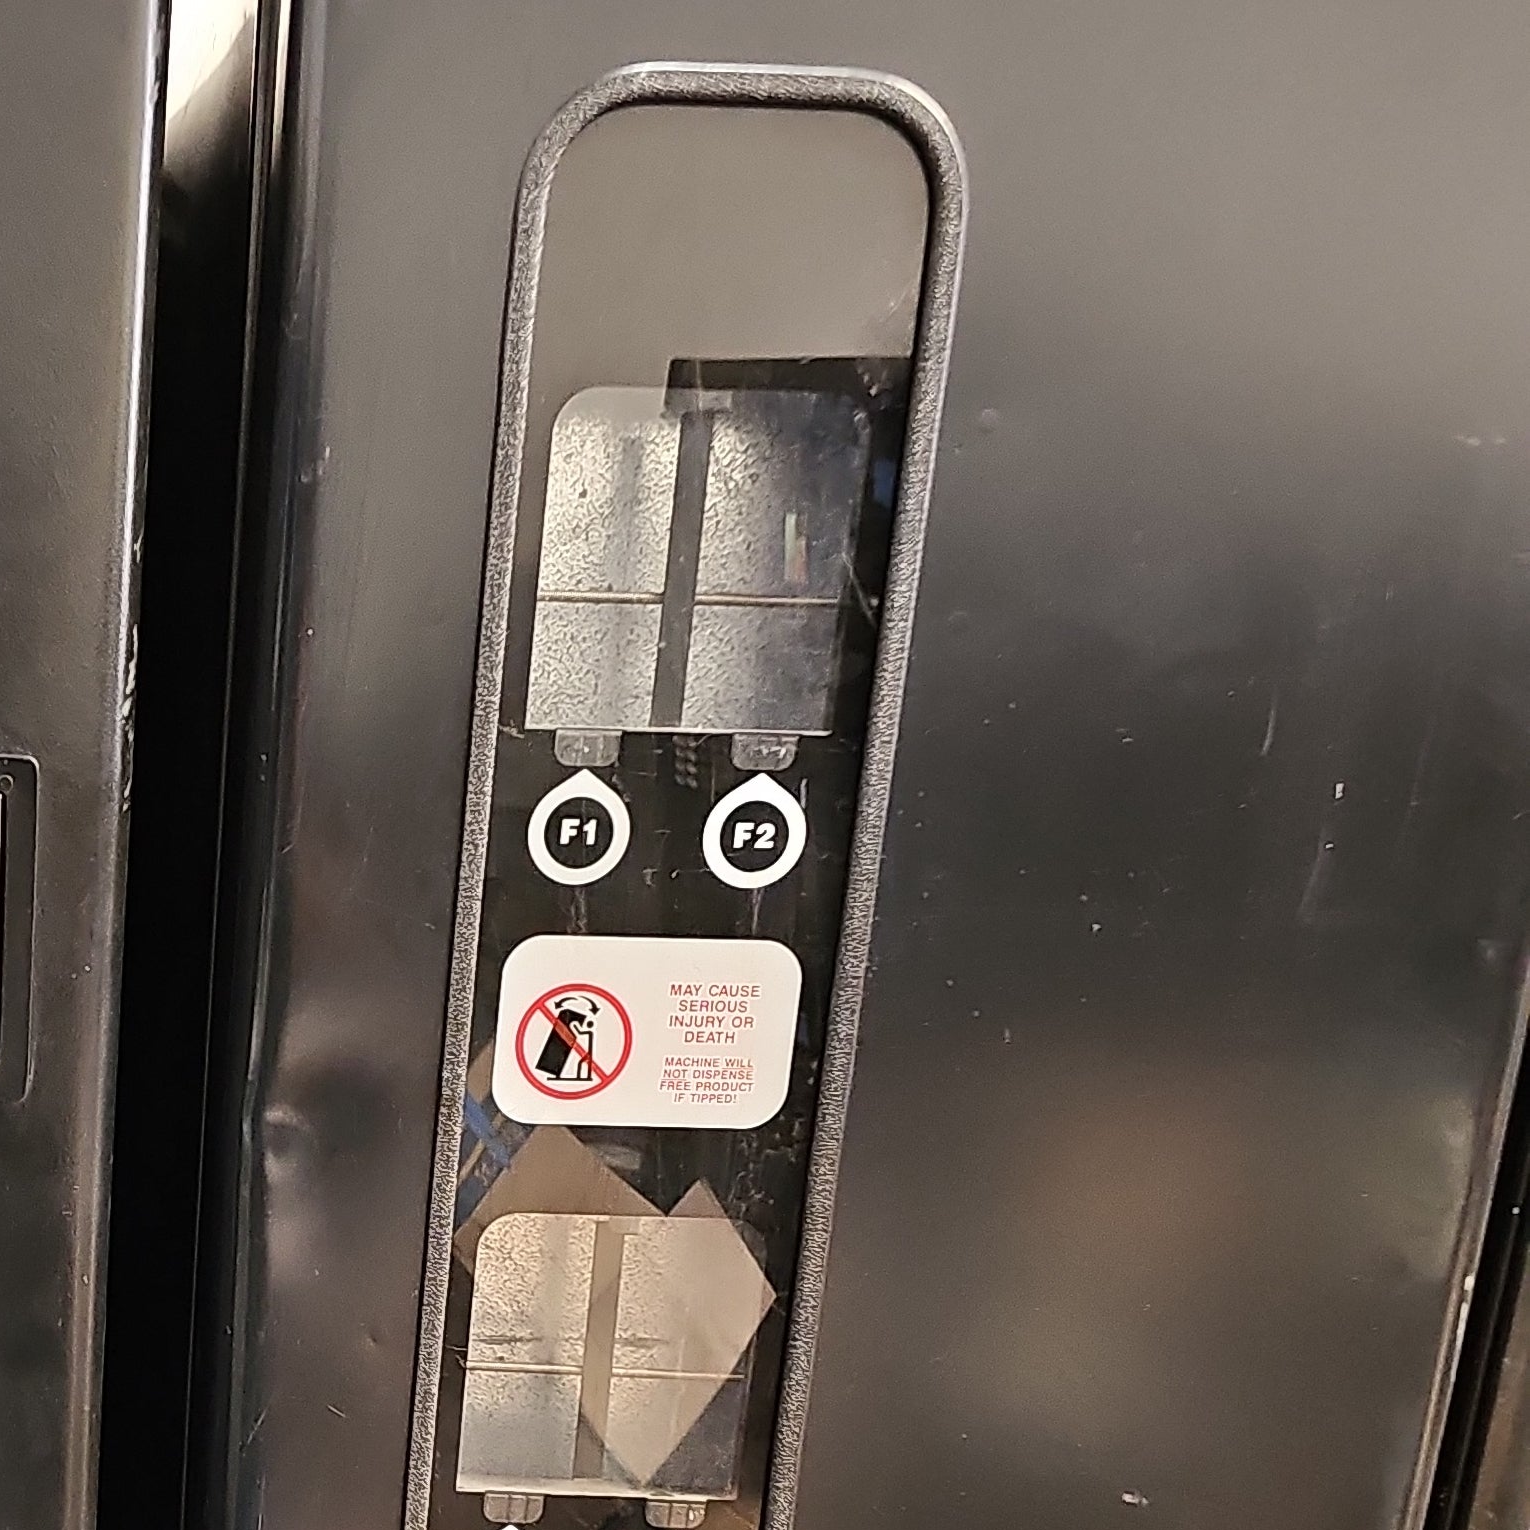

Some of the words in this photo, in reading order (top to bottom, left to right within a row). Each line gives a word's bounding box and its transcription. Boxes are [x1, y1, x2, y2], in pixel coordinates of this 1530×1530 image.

[559, 818, 598, 846] F1
[733, 821, 776, 849] F2
[669, 984, 702, 997] MAY
[708, 984, 761, 997] CAUSE
[678, 1000, 748, 1013] SERIOUS
[668, 1015, 725, 1028] INJURY
[731, 1016, 754, 1028] OR
[684, 1031, 735, 1044] DEATH
[664, 1057, 720, 1067] MACHINE
[724, 1058, 754, 1068] WILL
[663, 1069, 688, 1079] NOT
[692, 1070, 754, 1080] DISPENSE
[659, 1081, 691, 1091] FREE
[695, 1082, 754, 1092] PRODUCT
[673, 1093, 685, 1103] IF
[690, 1094, 737, 1104] TIPPED!
